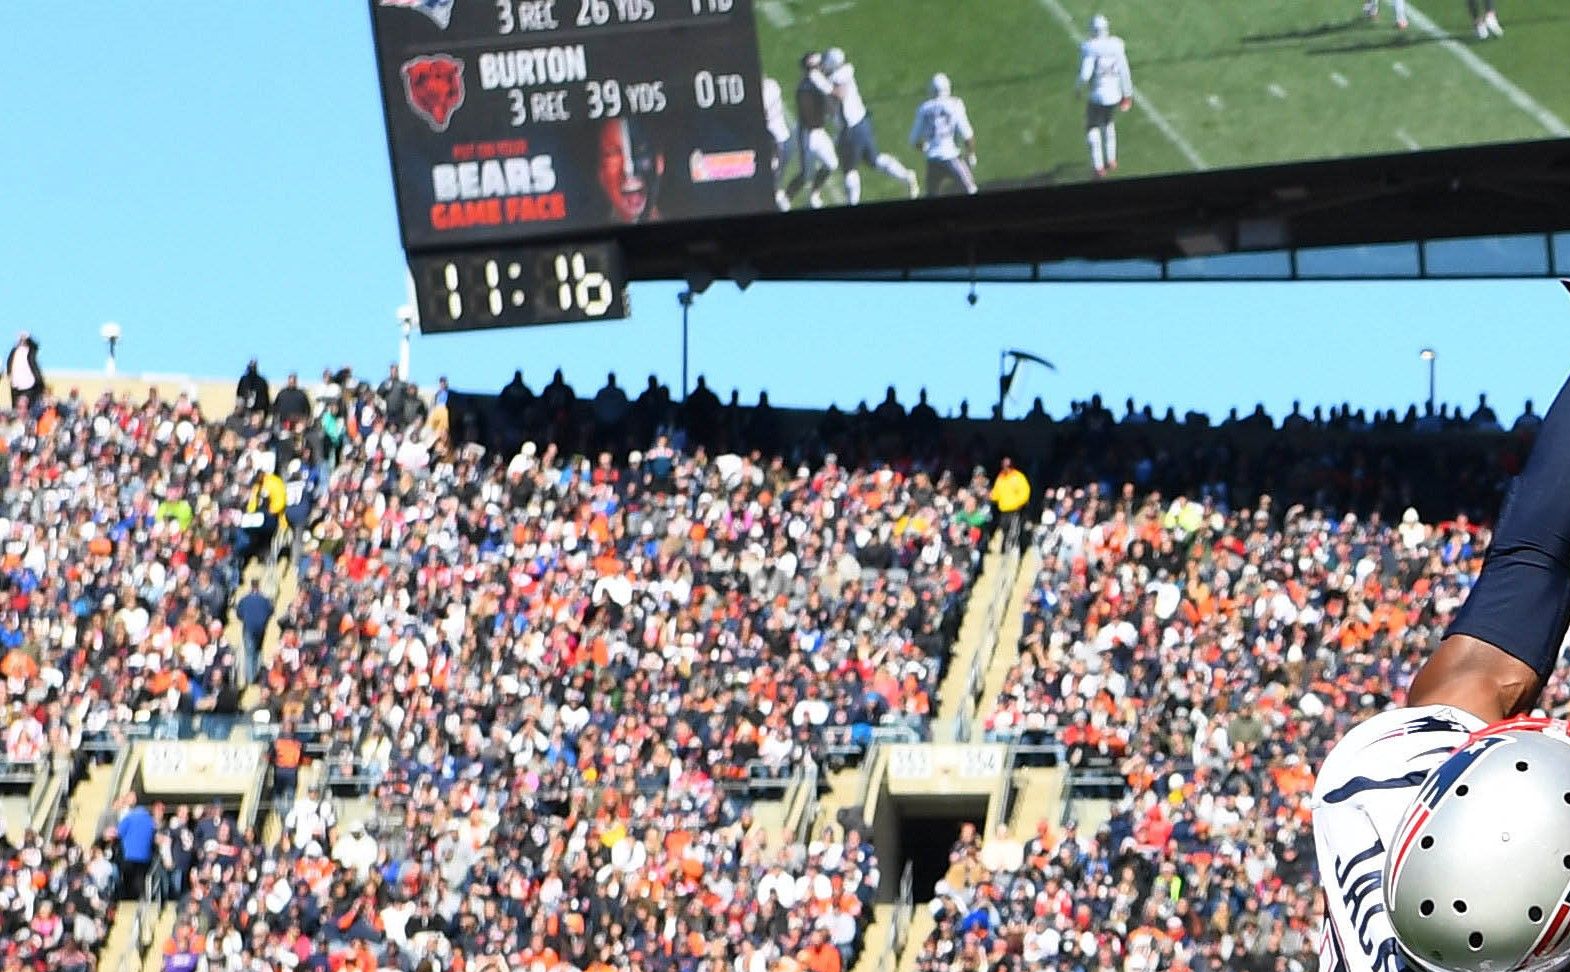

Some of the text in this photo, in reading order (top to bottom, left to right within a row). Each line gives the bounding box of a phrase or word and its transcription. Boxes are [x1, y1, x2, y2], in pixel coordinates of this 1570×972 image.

[520, 0, 560, 32] REC
[478, 45, 587, 90] BURTON
[510, 71, 745, 126] 3 REC 39 YDS 0 TD
[432, 155, 556, 201] BEARS
[430, 192, 566, 231] GAME FACE
[443, 252, 612, 320] 11:16
